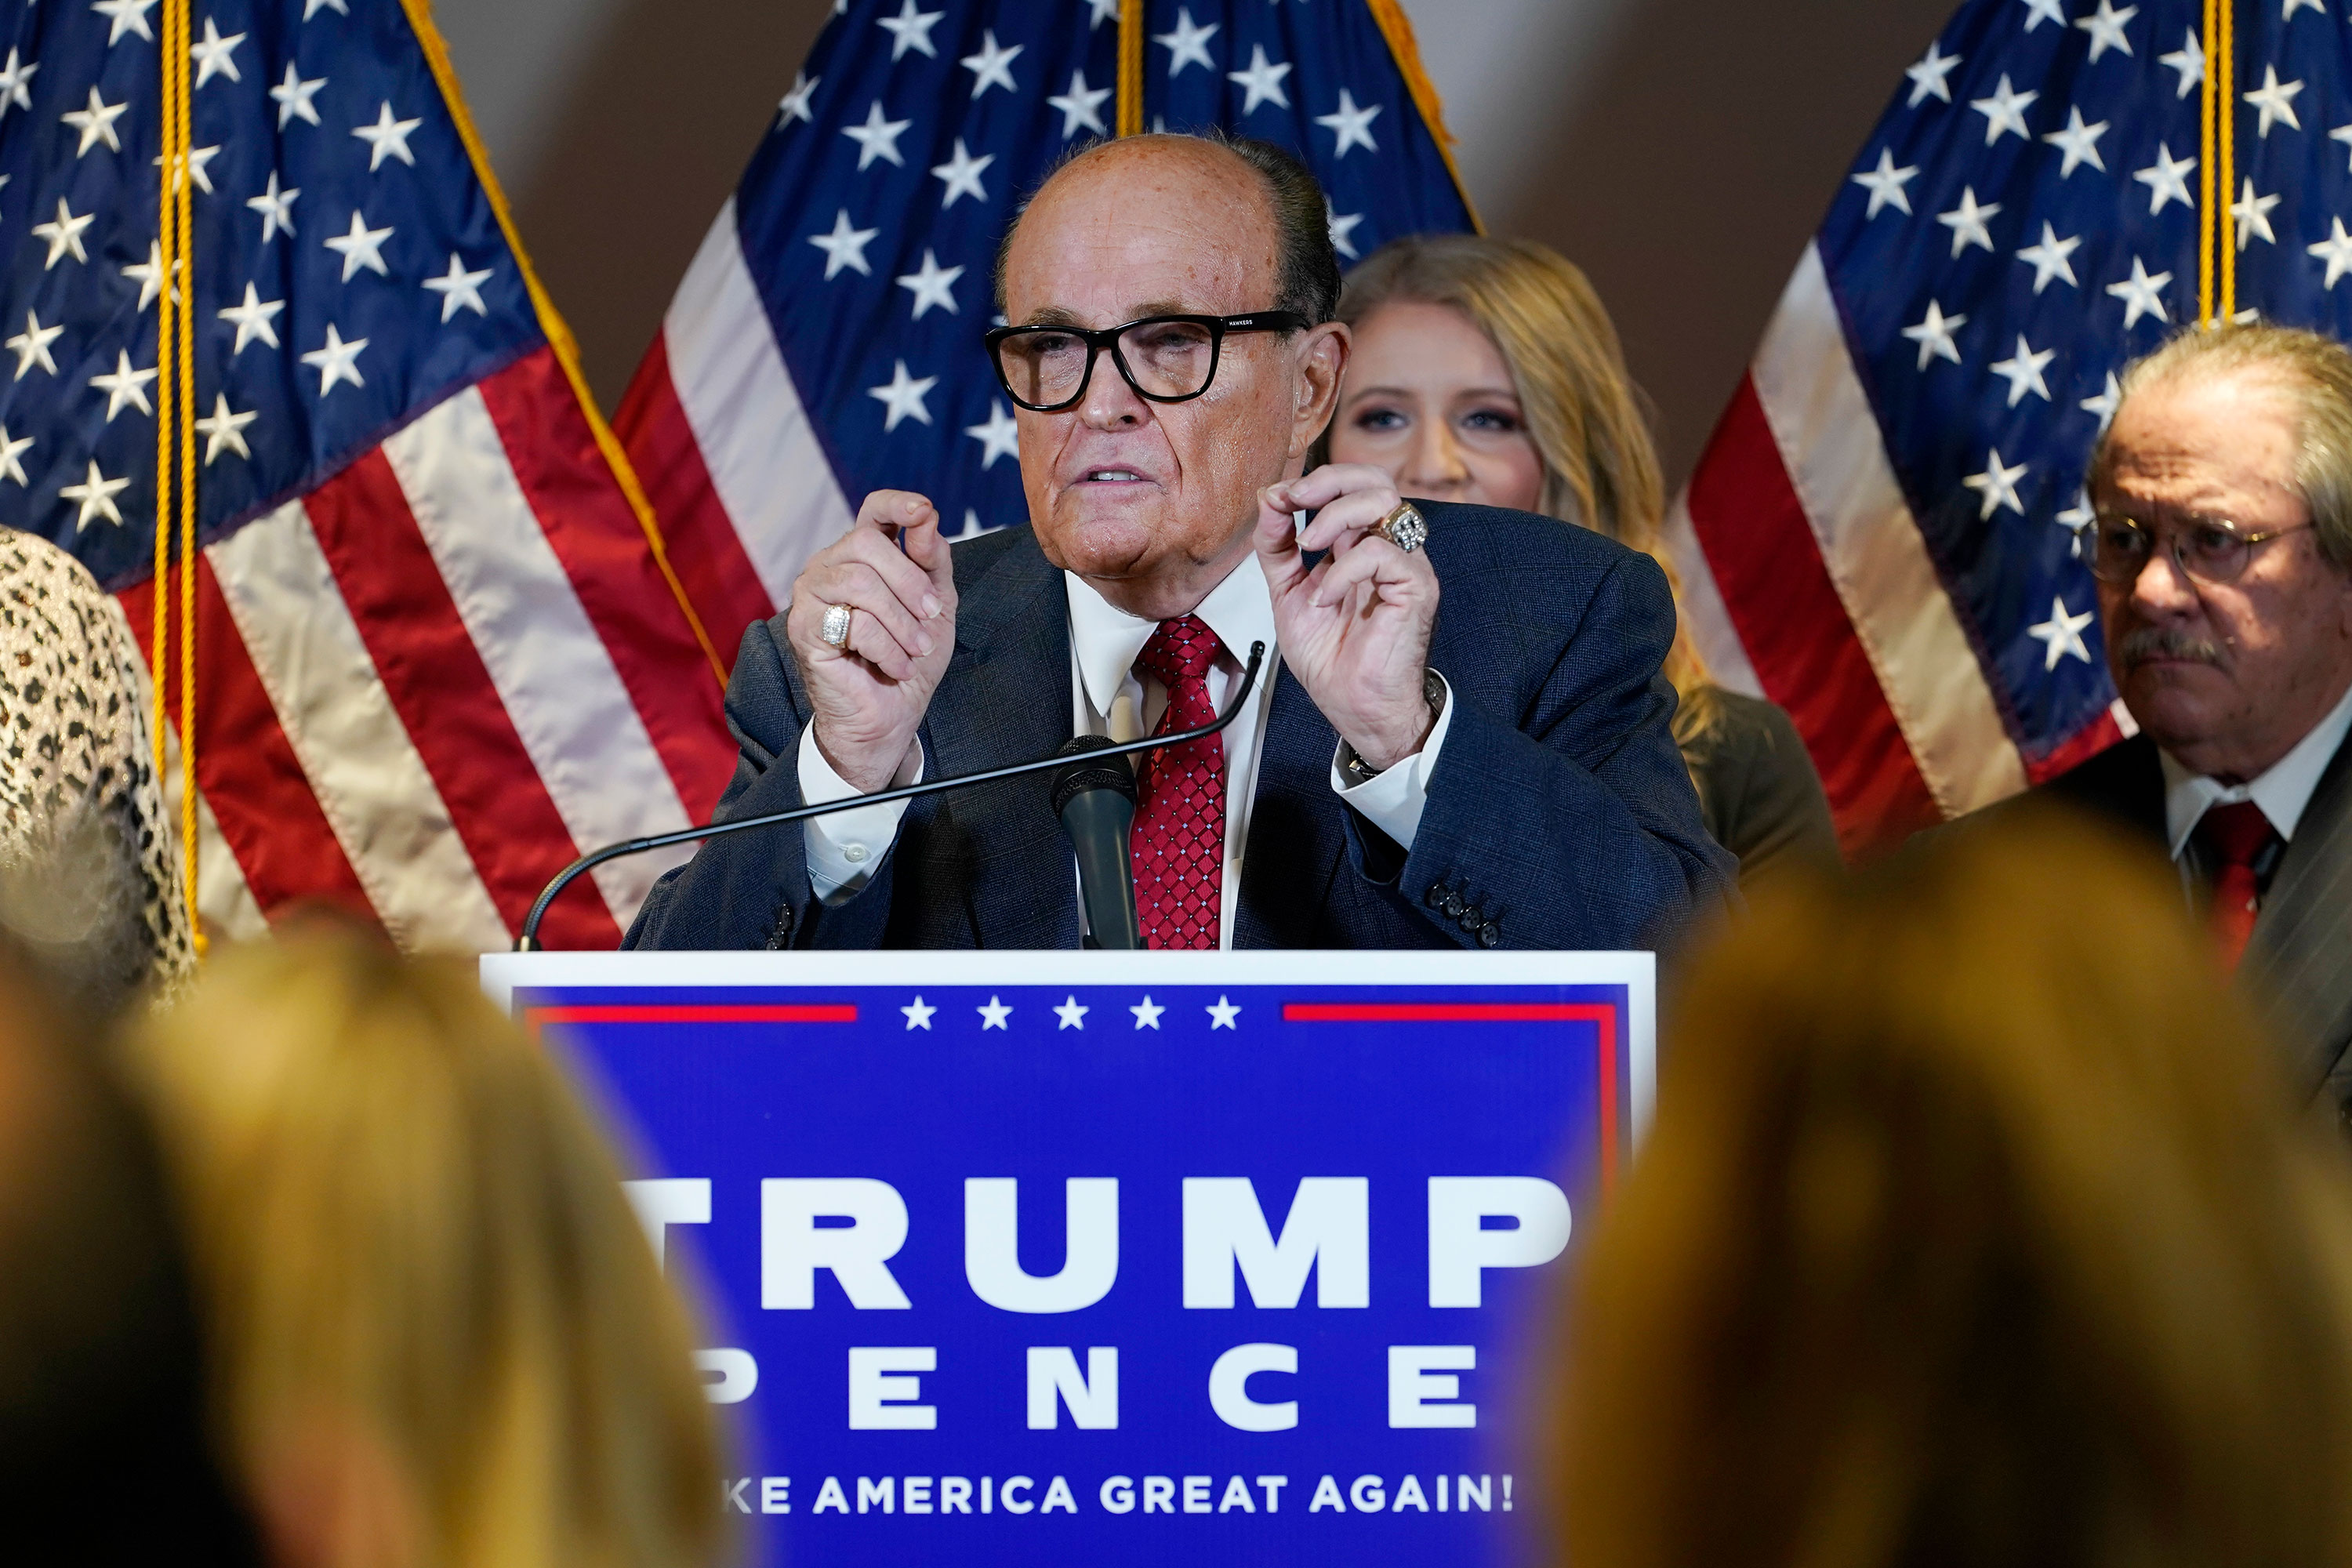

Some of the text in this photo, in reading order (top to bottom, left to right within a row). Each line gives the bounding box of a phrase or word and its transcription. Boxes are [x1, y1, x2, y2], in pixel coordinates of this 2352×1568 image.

[722, 1474, 1513, 1515] KE AMERICA GREAT AGAIN!
